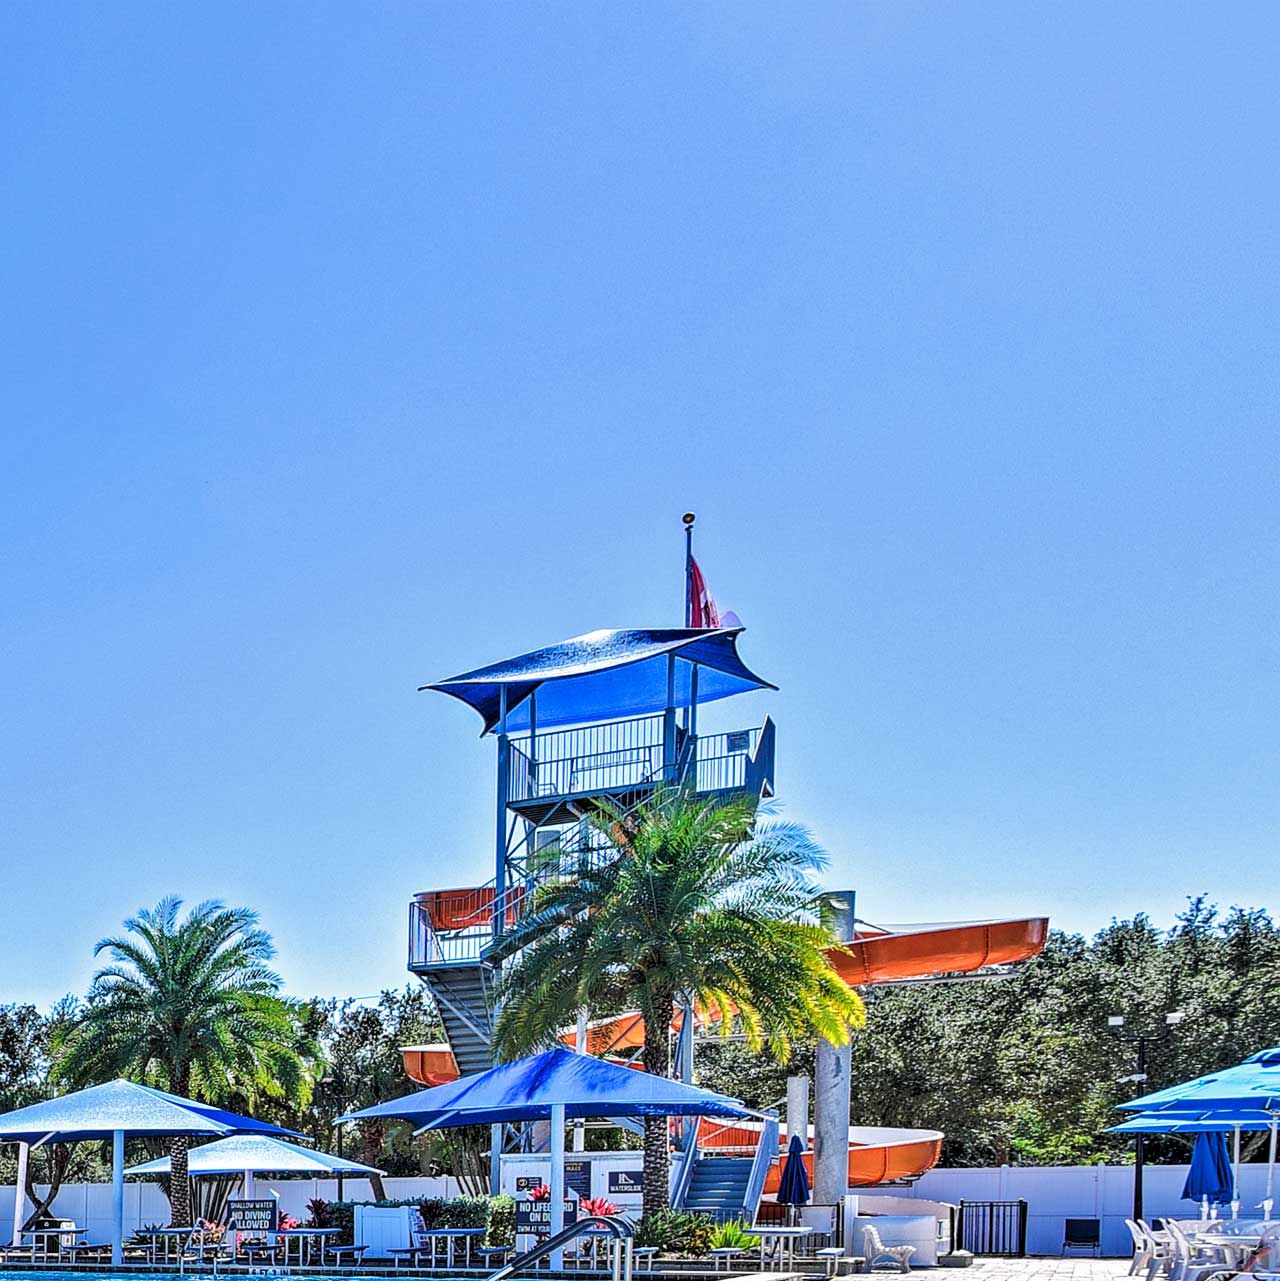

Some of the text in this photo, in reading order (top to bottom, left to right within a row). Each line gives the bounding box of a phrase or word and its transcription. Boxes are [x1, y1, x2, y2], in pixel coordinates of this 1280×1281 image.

[519, 1202, 574, 1212] NO LIFEGRD
[231, 1211, 271, 1220] NO DIVING
[529, 1212, 541, 1222] ON
